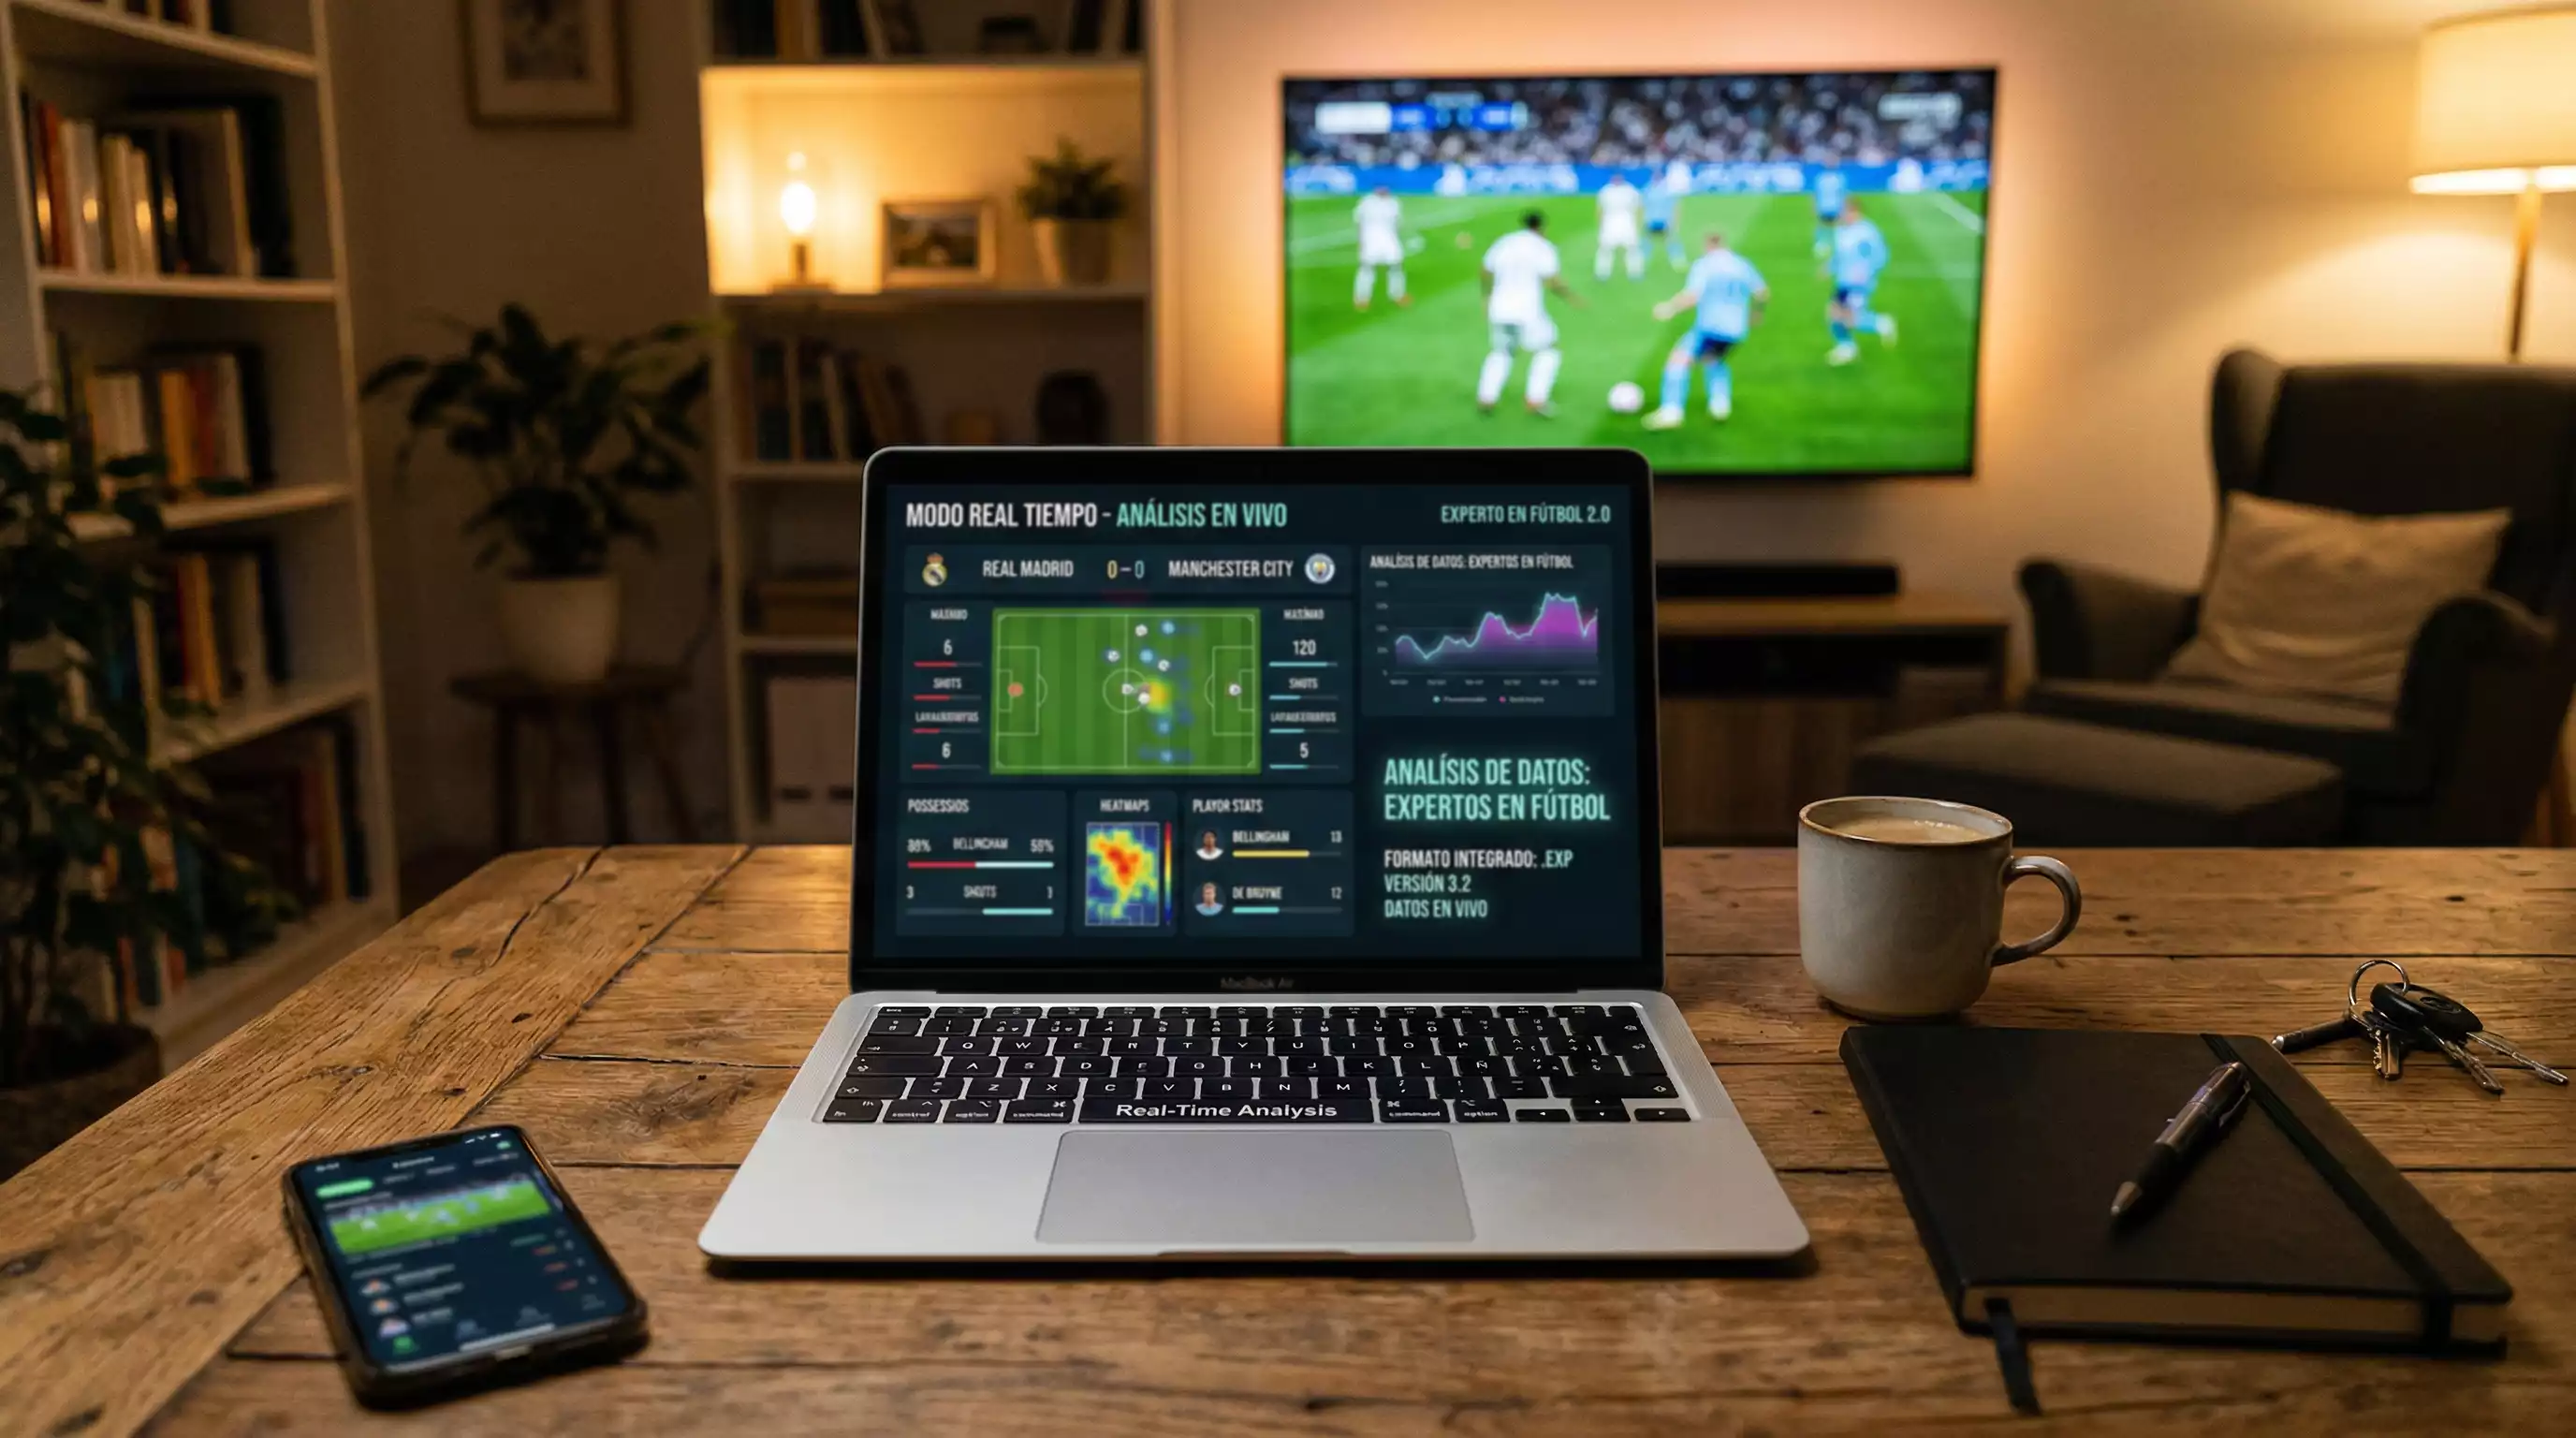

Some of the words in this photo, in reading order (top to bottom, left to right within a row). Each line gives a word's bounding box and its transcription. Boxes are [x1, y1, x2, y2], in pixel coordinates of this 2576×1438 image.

[906, 503, 964, 527] MODO
[969, 503, 1019, 527] REAL
[1023, 502, 1098, 528] TIEMPO
[1116, 498, 1207, 528] ANÁLISIS
[1211, 502, 1237, 527] EN
[1242, 503, 1287, 527] VIVO
[1441, 505, 1505, 523] EXPERTO
[1507, 505, 1527, 523] EN
[1530, 502, 1584, 523] FÚTBOL
[1587, 505, 1611, 523] 2.0
[982, 559, 1017, 578] REAL
[1019, 560, 1075, 578] MADRID
[1168, 560, 1261, 578] MANCHESTER
[1263, 559, 1294, 578] CITY
[1416, 554, 1430, 569] DE
[1468, 554, 1519, 569] EXPERTOS
[1520, 554, 1534, 569] EN
[944, 638, 953, 655] 6
[1293, 638, 1317, 656] 120
[1299, 741, 1310, 759] 5
[1383, 753, 1480, 786] ANALÍSIS
[1485, 758, 1513, 785] DE
[1517, 758, 1590, 785] DATOS:
[1100, 799, 1149, 813] HEATMAPS
[1232, 799, 1264, 813] STATS
[1384, 793, 1492, 821] EXPERTOS
[1498, 793, 1525, 820] EN
[1530, 787, 1611, 821] FÚTBOL
[1383, 849, 1451, 869] FORMATO
[1454, 849, 1537, 869] INTEGRADO:
[1541, 849, 1573, 869] .EXP
[1383, 873, 1445, 893] VERSIÓN
[1447, 873, 1471, 893] 3.2
[1384, 899, 1430, 918] DATOS
[1432, 899, 1452, 918] EN
[1455, 899, 1488, 918] VIVO
[988, 1083, 1000, 1092] Z
[1046, 1083, 1058, 1092] X
[1163, 1083, 1175, 1092] V
[1116, 1104, 1232, 1117] Real-Time
[1237, 1104, 1338, 1120] Analysis
